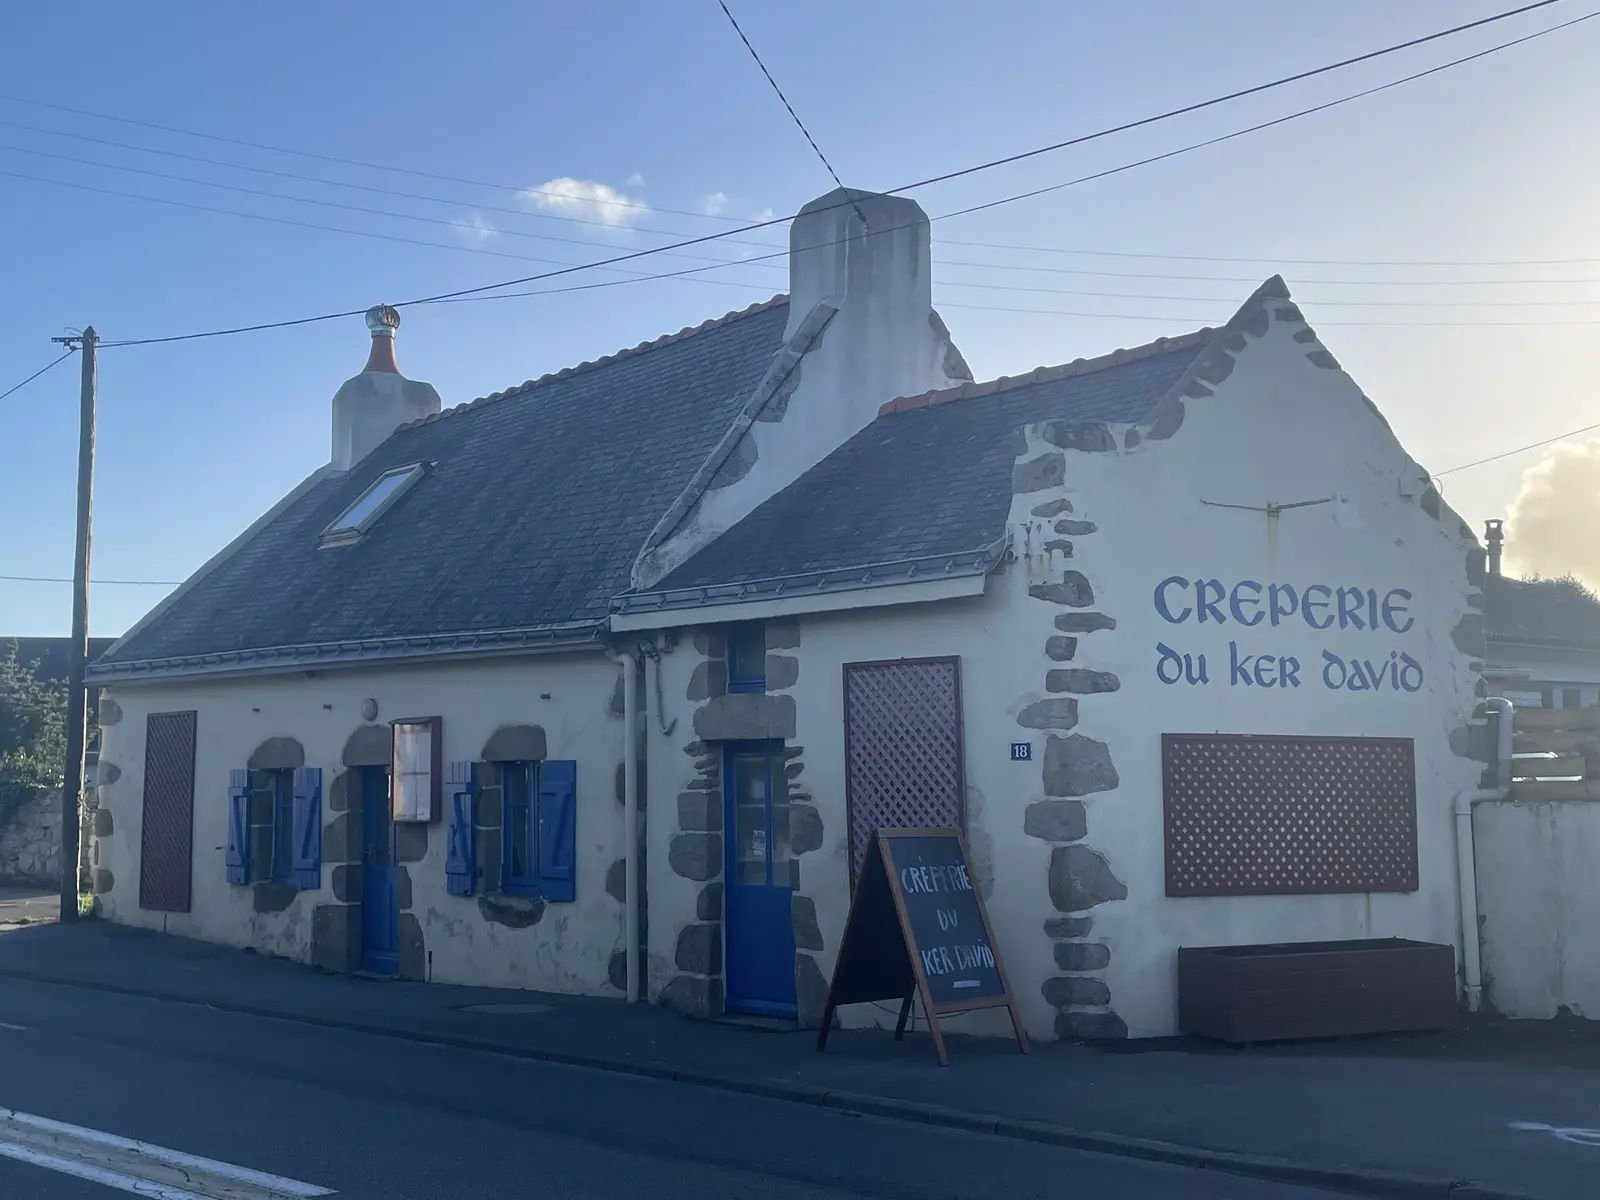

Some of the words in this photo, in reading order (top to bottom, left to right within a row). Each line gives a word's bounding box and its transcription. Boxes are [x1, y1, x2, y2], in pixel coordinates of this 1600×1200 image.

[1153, 575, 1415, 633] CREPERIE
[1014, 744, 1028, 758] 18
[936, 909, 958, 931] DU
[921, 945, 954, 975] KER
